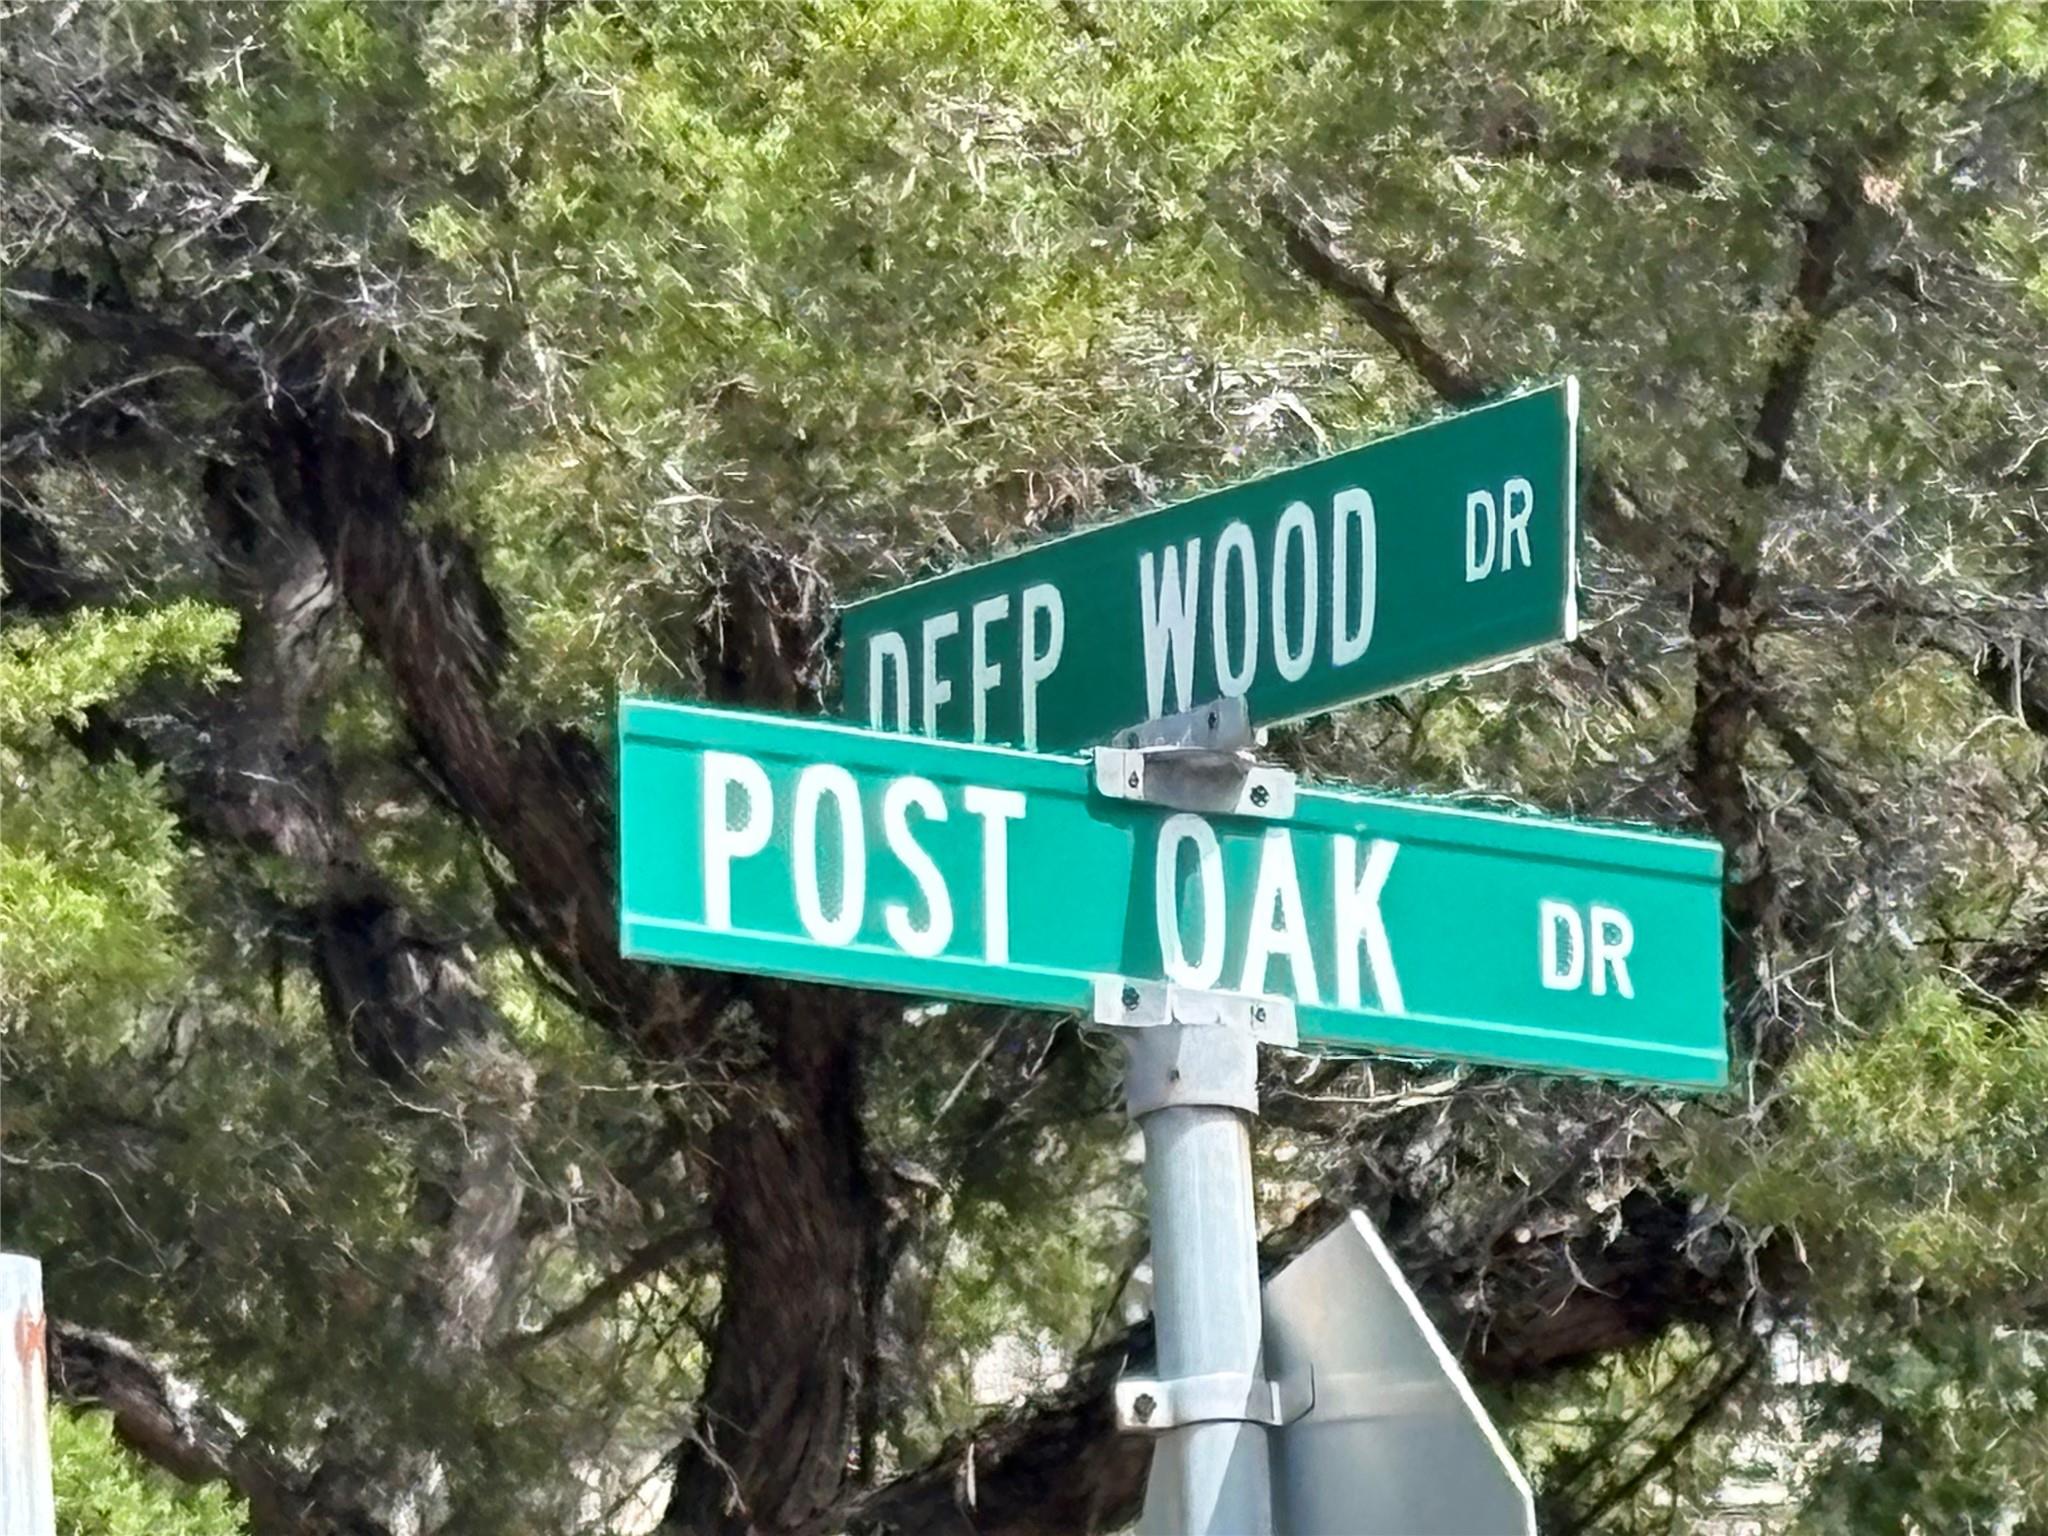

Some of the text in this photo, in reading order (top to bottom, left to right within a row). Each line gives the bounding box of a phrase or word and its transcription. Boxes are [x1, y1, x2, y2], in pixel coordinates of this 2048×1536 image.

[869, 478, 1533, 752] DEEP WOOD DR
[702, 751, 1635, 1016] POST OAK DR
